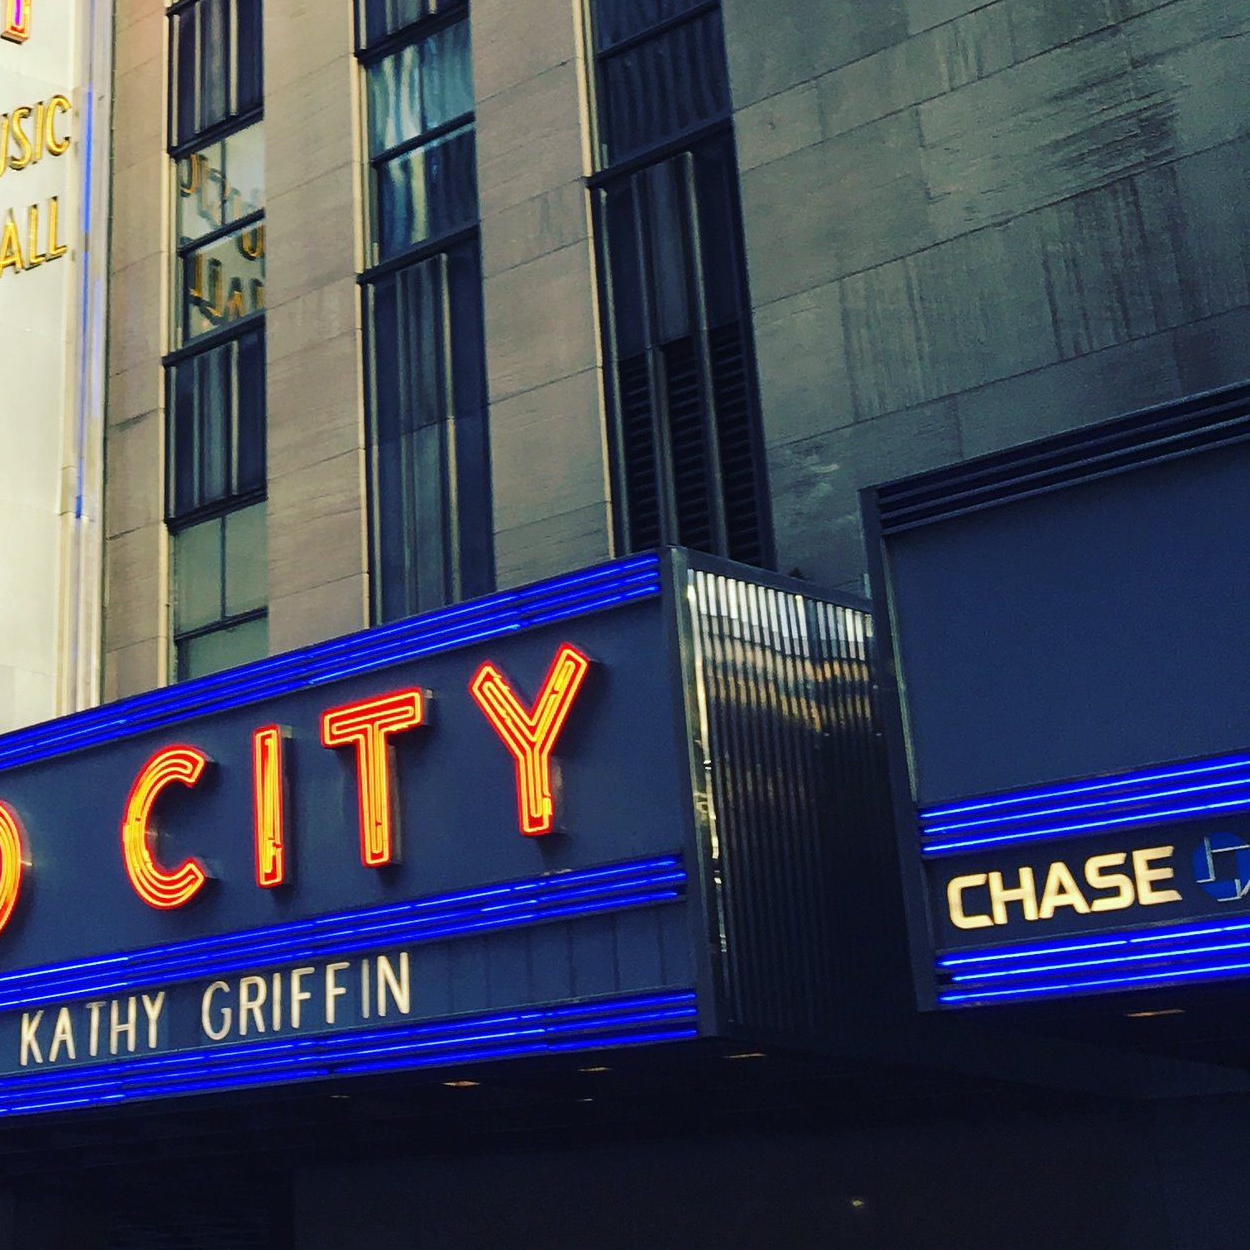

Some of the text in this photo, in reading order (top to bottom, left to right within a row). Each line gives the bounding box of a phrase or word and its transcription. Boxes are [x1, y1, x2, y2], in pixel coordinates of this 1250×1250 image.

[122, 642, 589, 909] CITY
[947, 845, 1182, 929] CHASE
[20, 991, 166, 1066] KATHY
[202, 951, 411, 1041] GRIFFIN
